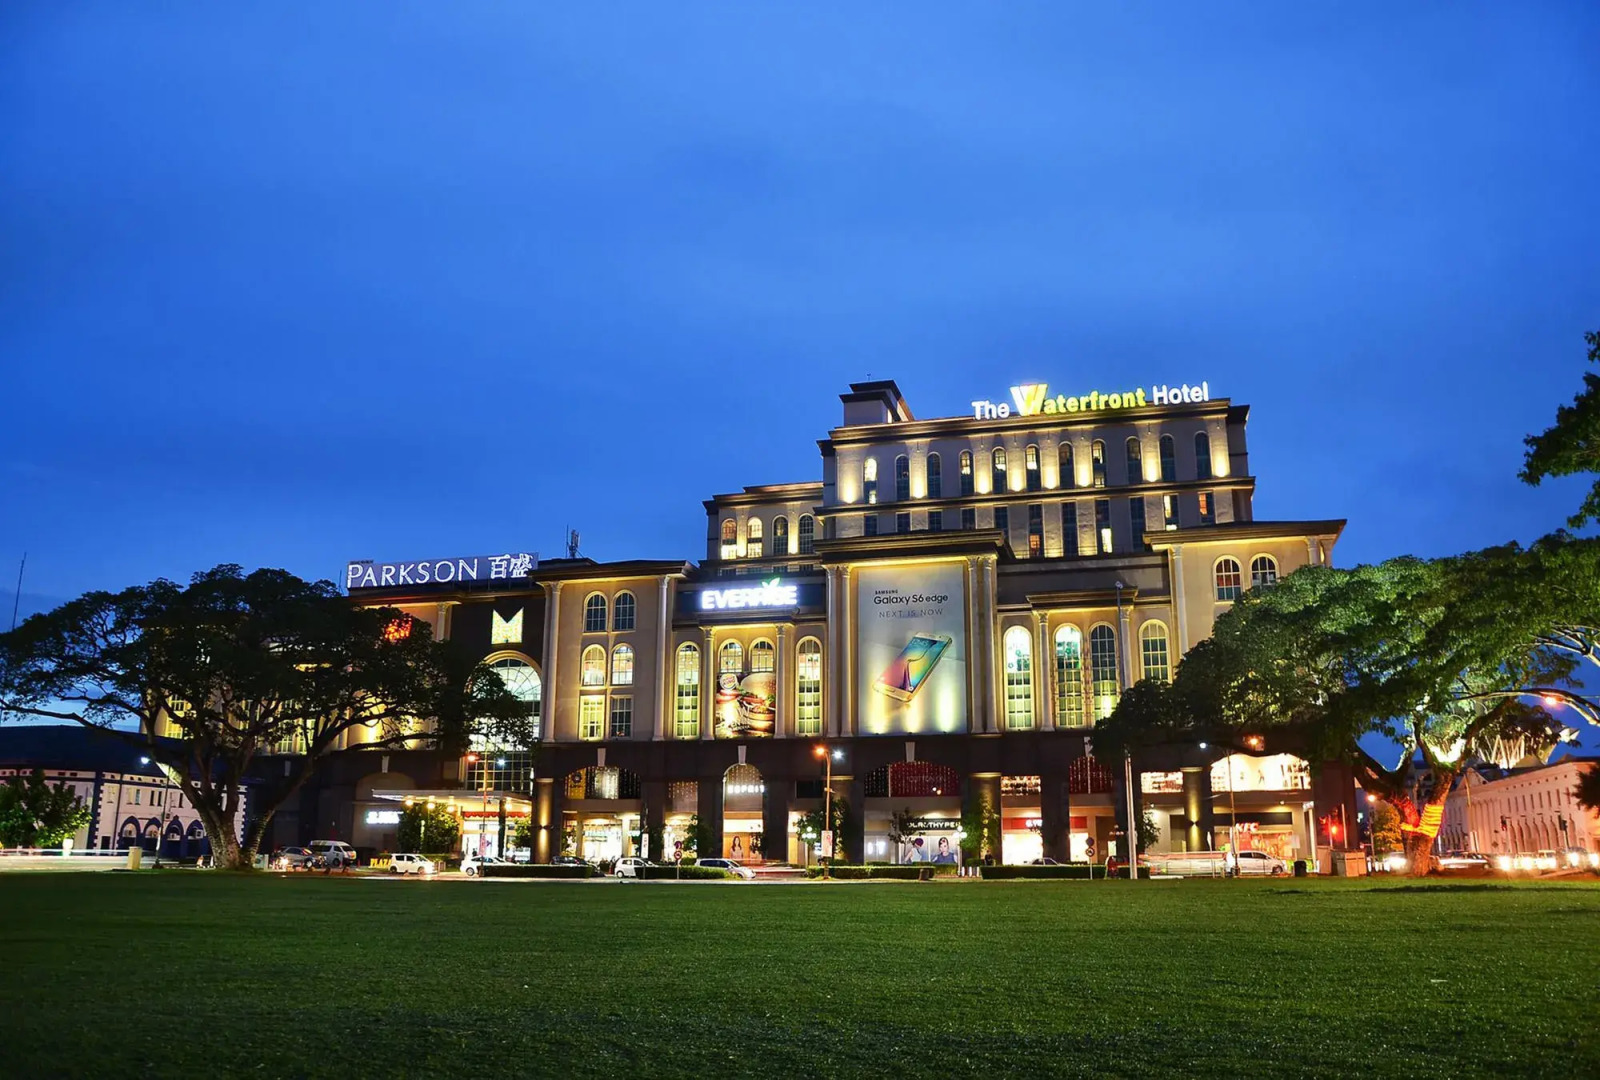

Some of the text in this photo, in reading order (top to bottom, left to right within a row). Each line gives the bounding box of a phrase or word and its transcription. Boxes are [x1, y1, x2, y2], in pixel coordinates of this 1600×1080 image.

[972, 381, 1209, 420] The Waterfront Hotel
[347, 558, 478, 588] PARKSON
[488, 553, 534, 579] 百盛
[873, 594, 949, 605] Galaxy S6 edge
[879, 610, 903, 618] NEXT
[921, 608, 943, 616] NOW
[1235, 822, 1259, 832] KFC
